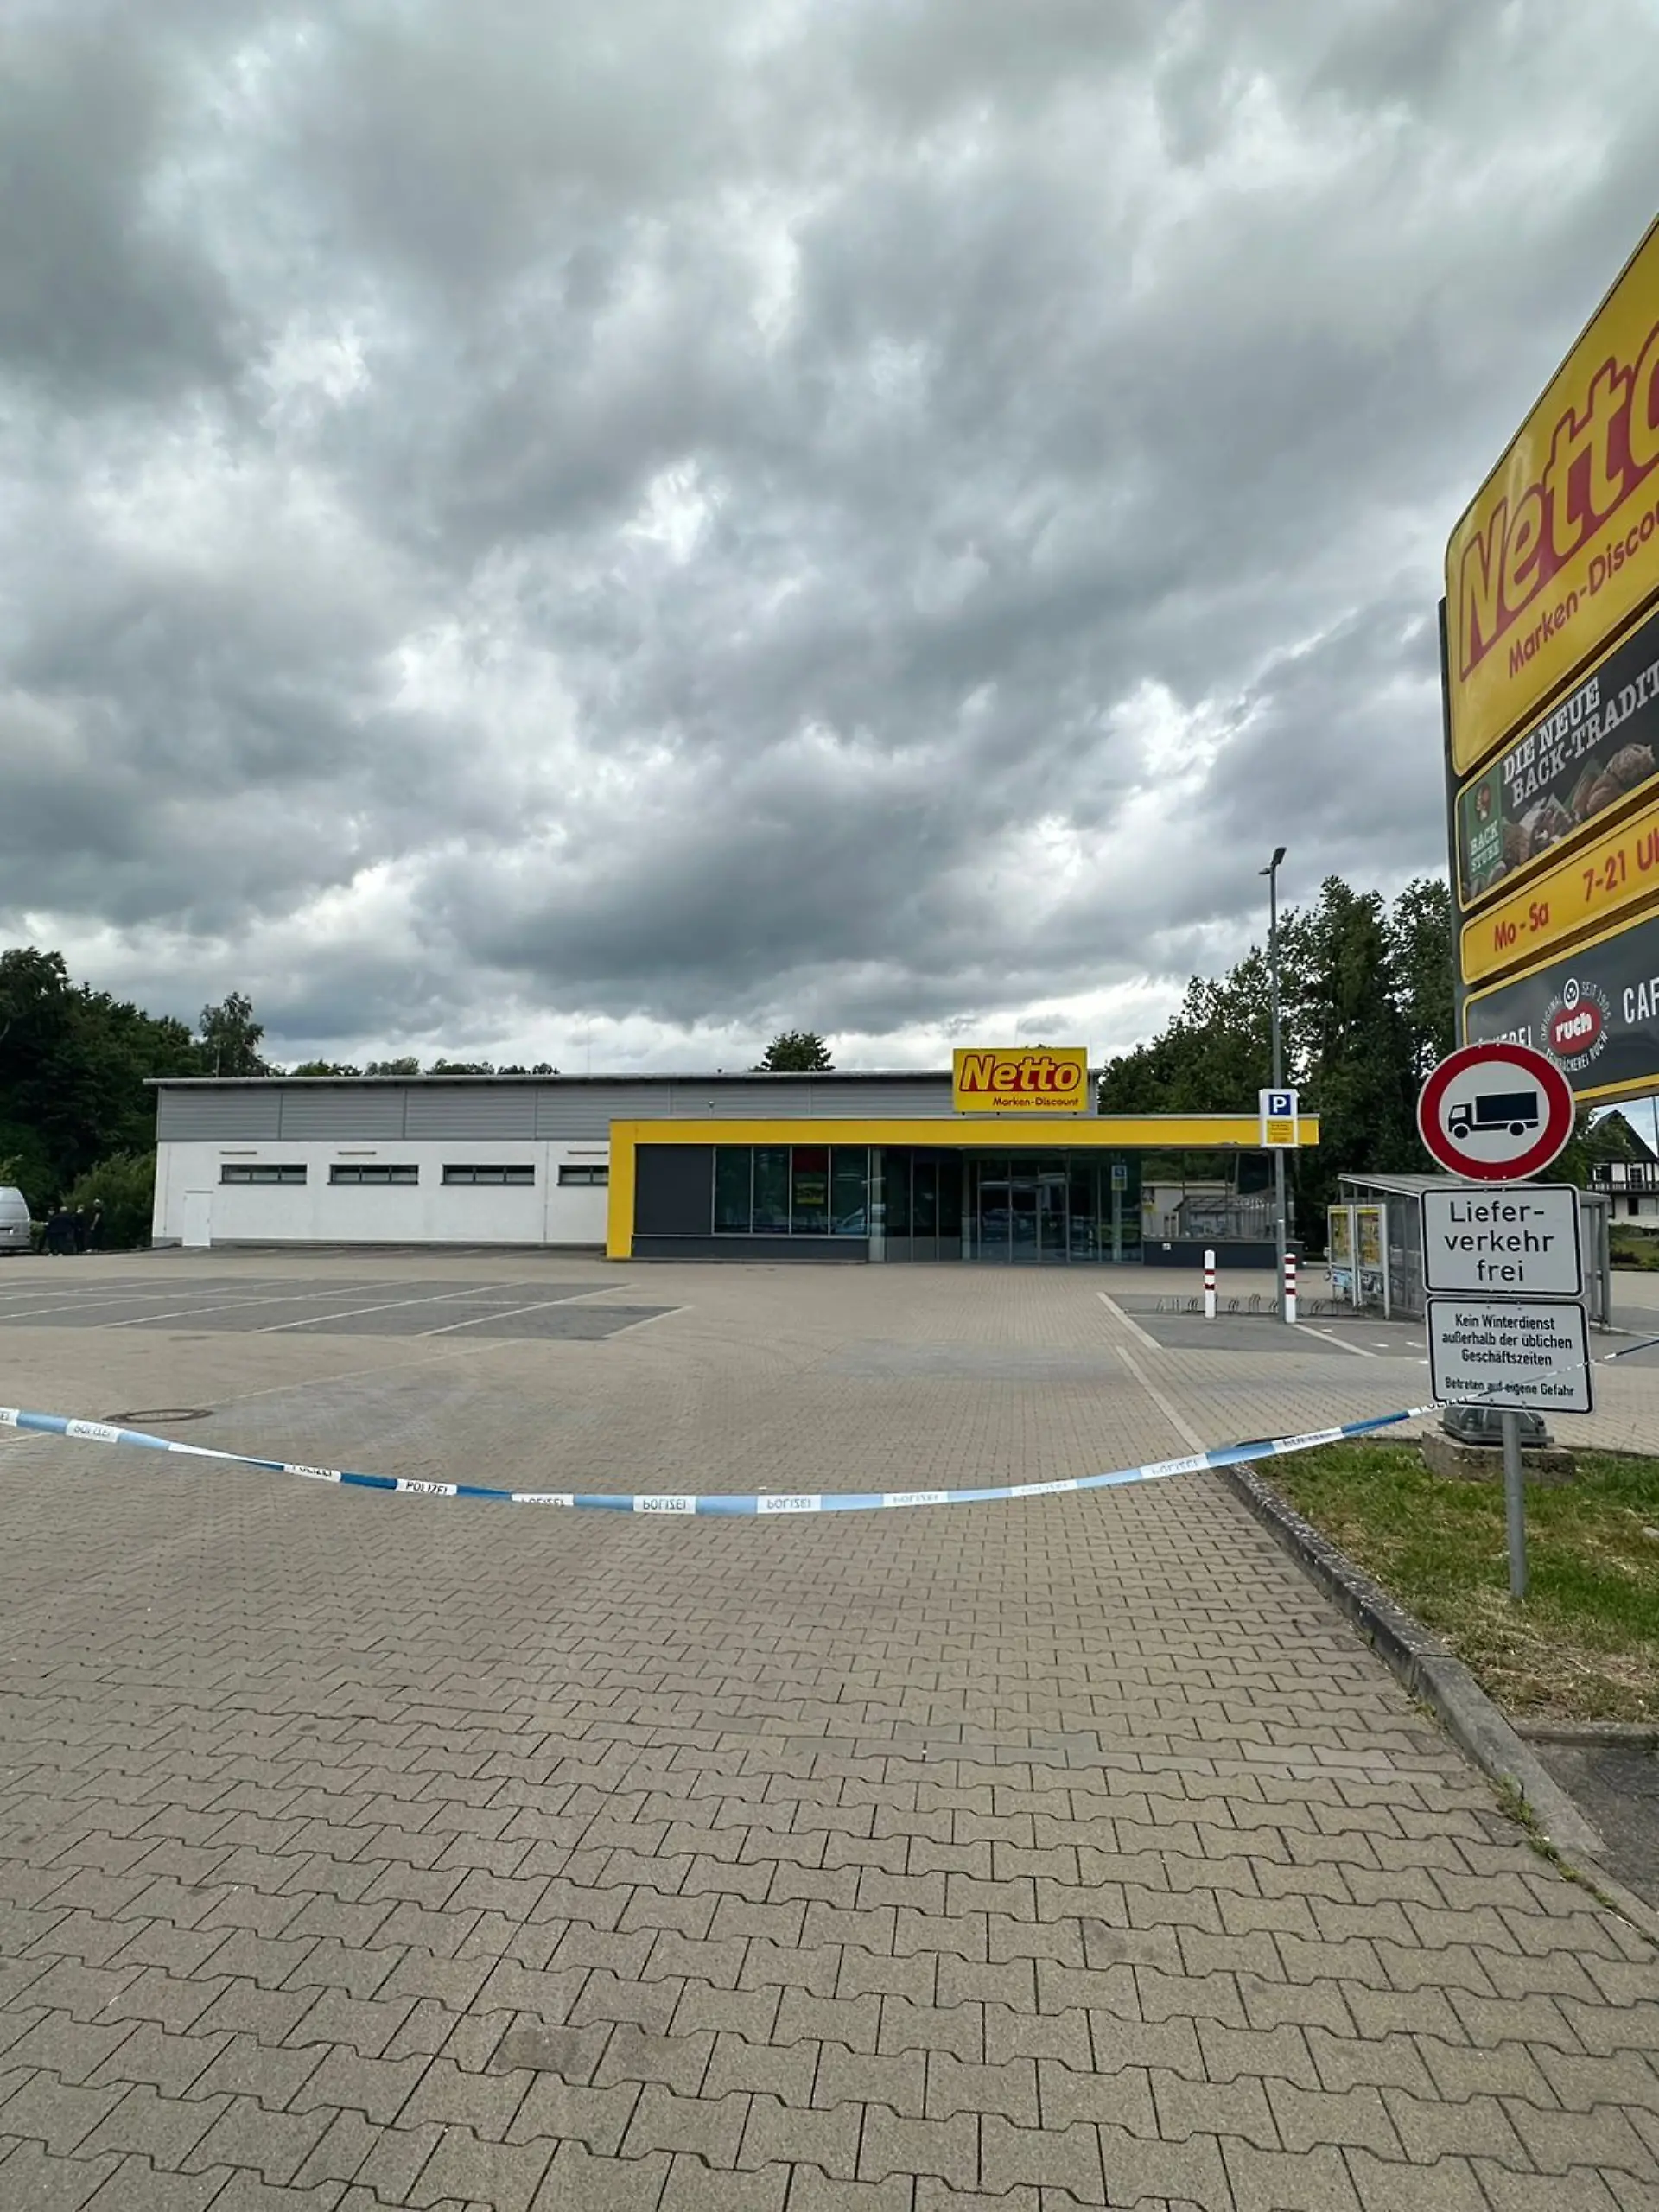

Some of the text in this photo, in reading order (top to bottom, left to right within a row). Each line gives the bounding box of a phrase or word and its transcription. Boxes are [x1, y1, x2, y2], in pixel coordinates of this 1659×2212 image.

[1503, 677, 1599, 785] DIE NEUE
[1470, 820, 1499, 856] BACK
[1494, 920, 1516, 951] Mo
[1529, 901, 1550, 932] Sa
[1583, 849, 1626, 901] 7-21
[1623, 976, 1659, 1024] CAF
[1555, 1012, 1592, 1042] ruch
[959, 1054, 1082, 1091] Netto
[993, 1096, 1079, 1107] Marken-Discount
[1273, 1096, 1287, 1114] P
[1450, 1200, 1545, 1223] Liefer-
[1445, 1230, 1554, 1252] verkehr
[1477, 1260, 1524, 1281] frei
[1455, 1313, 1555, 1330] Kein Winterdienst
[1442, 1332, 1573, 1349] außerhalb der üblichen
[1461, 1349, 1552, 1366] Geschäftszeiten
[1445, 1376, 1485, 1390] Betreten
[1503, 1381, 1538, 1395] eigene
[1540, 1382, 1575, 1396] Gefahr
